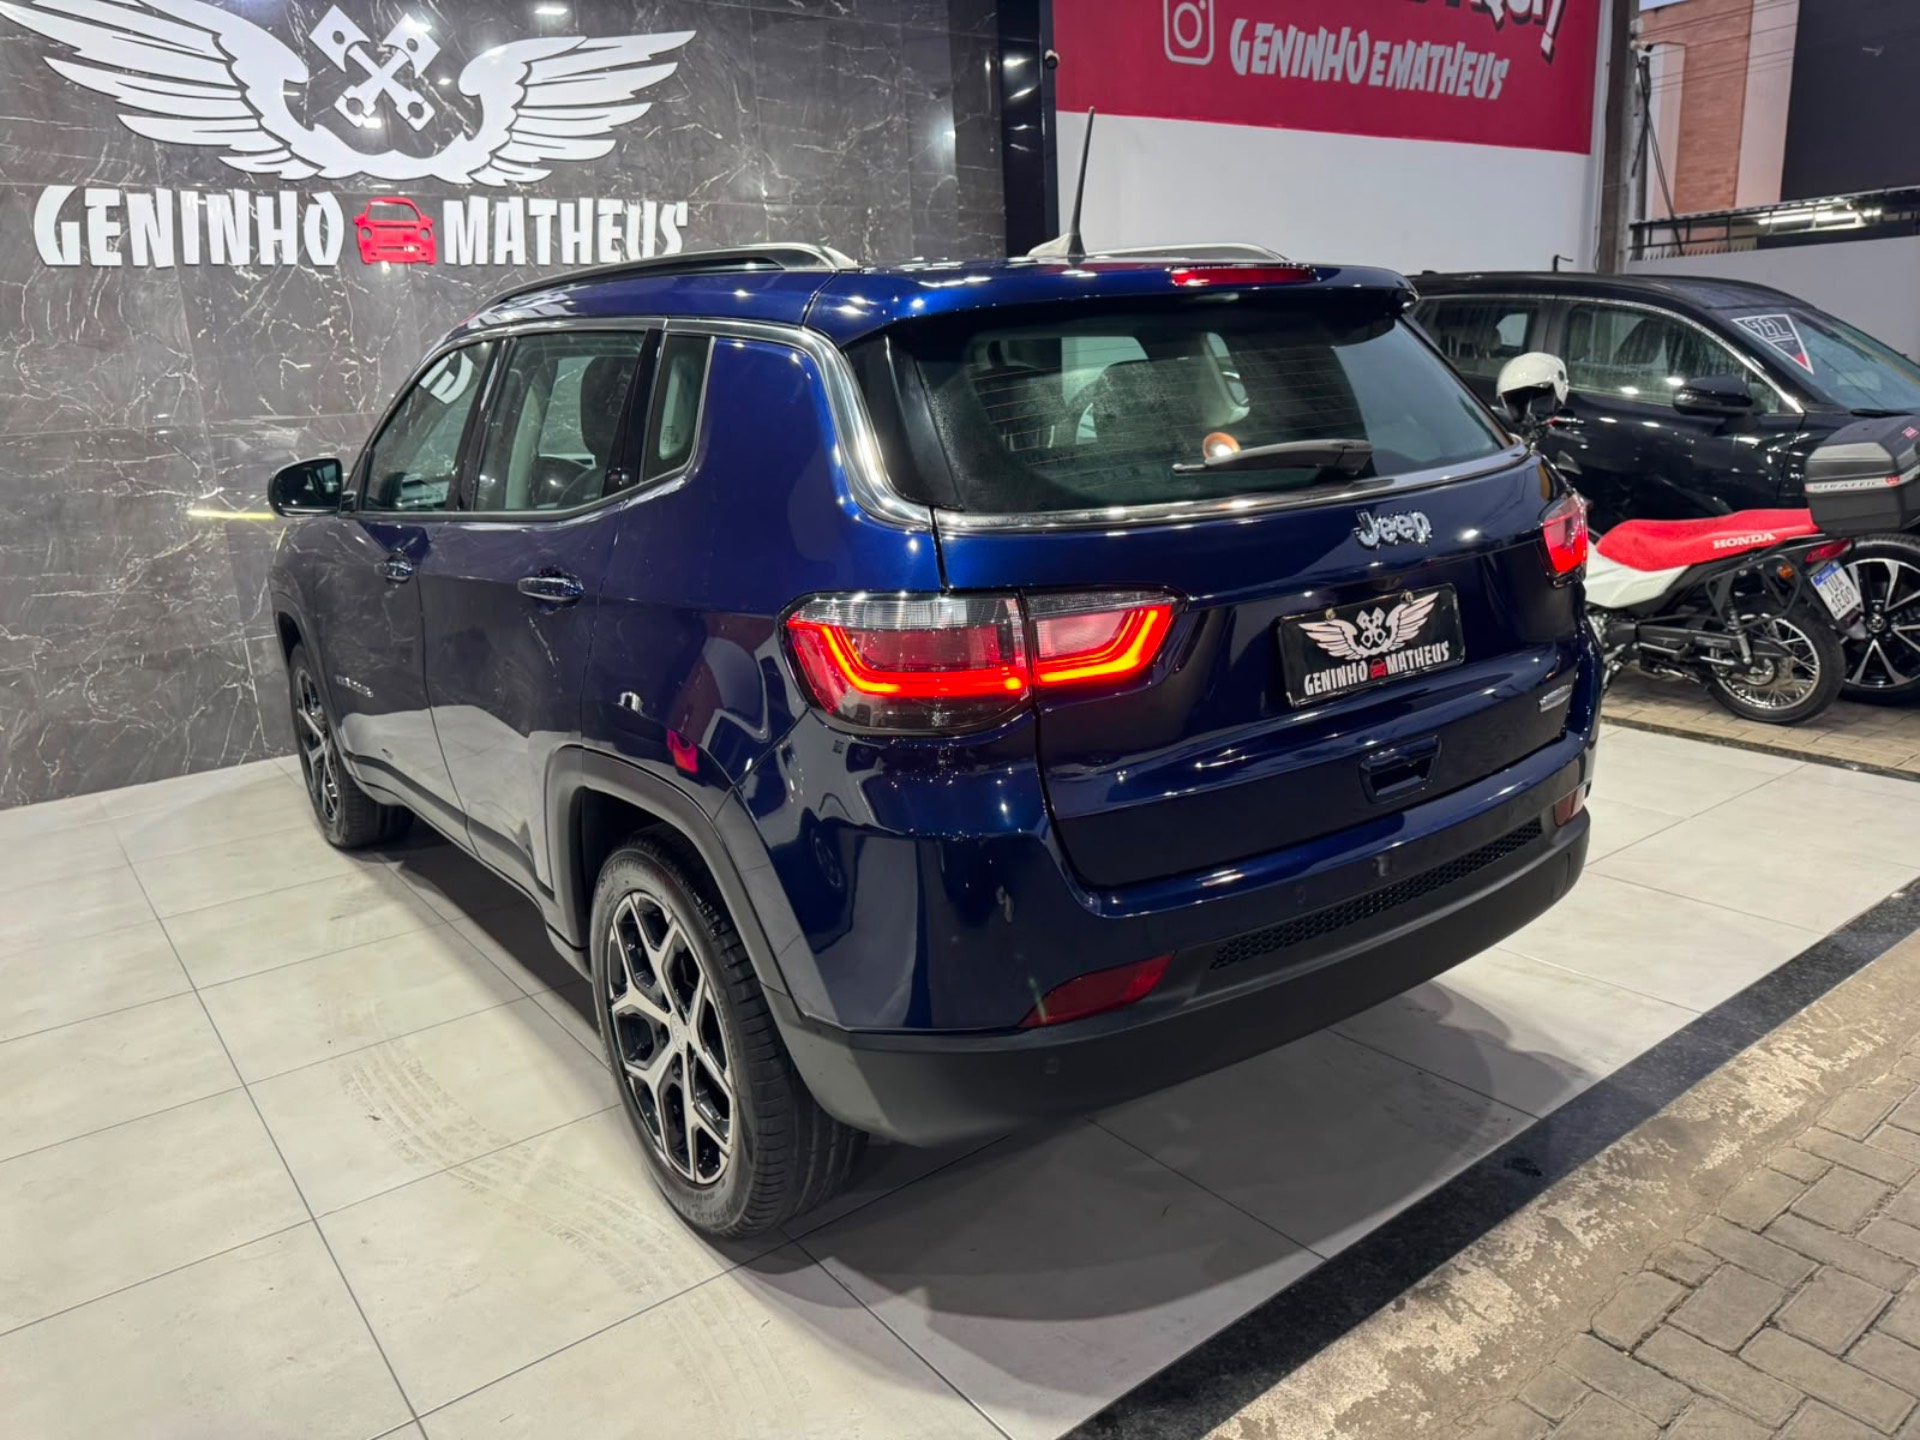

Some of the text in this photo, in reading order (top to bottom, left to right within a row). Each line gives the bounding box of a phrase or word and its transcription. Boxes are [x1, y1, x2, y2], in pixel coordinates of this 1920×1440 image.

[33, 185, 688, 268] GENINHO MATHEUS
[1354, 509, 1433, 547] Jeep
[1712, 532, 1776, 549] HONDA
[1304, 641, 1450, 696] GENINHO MATHEUS
